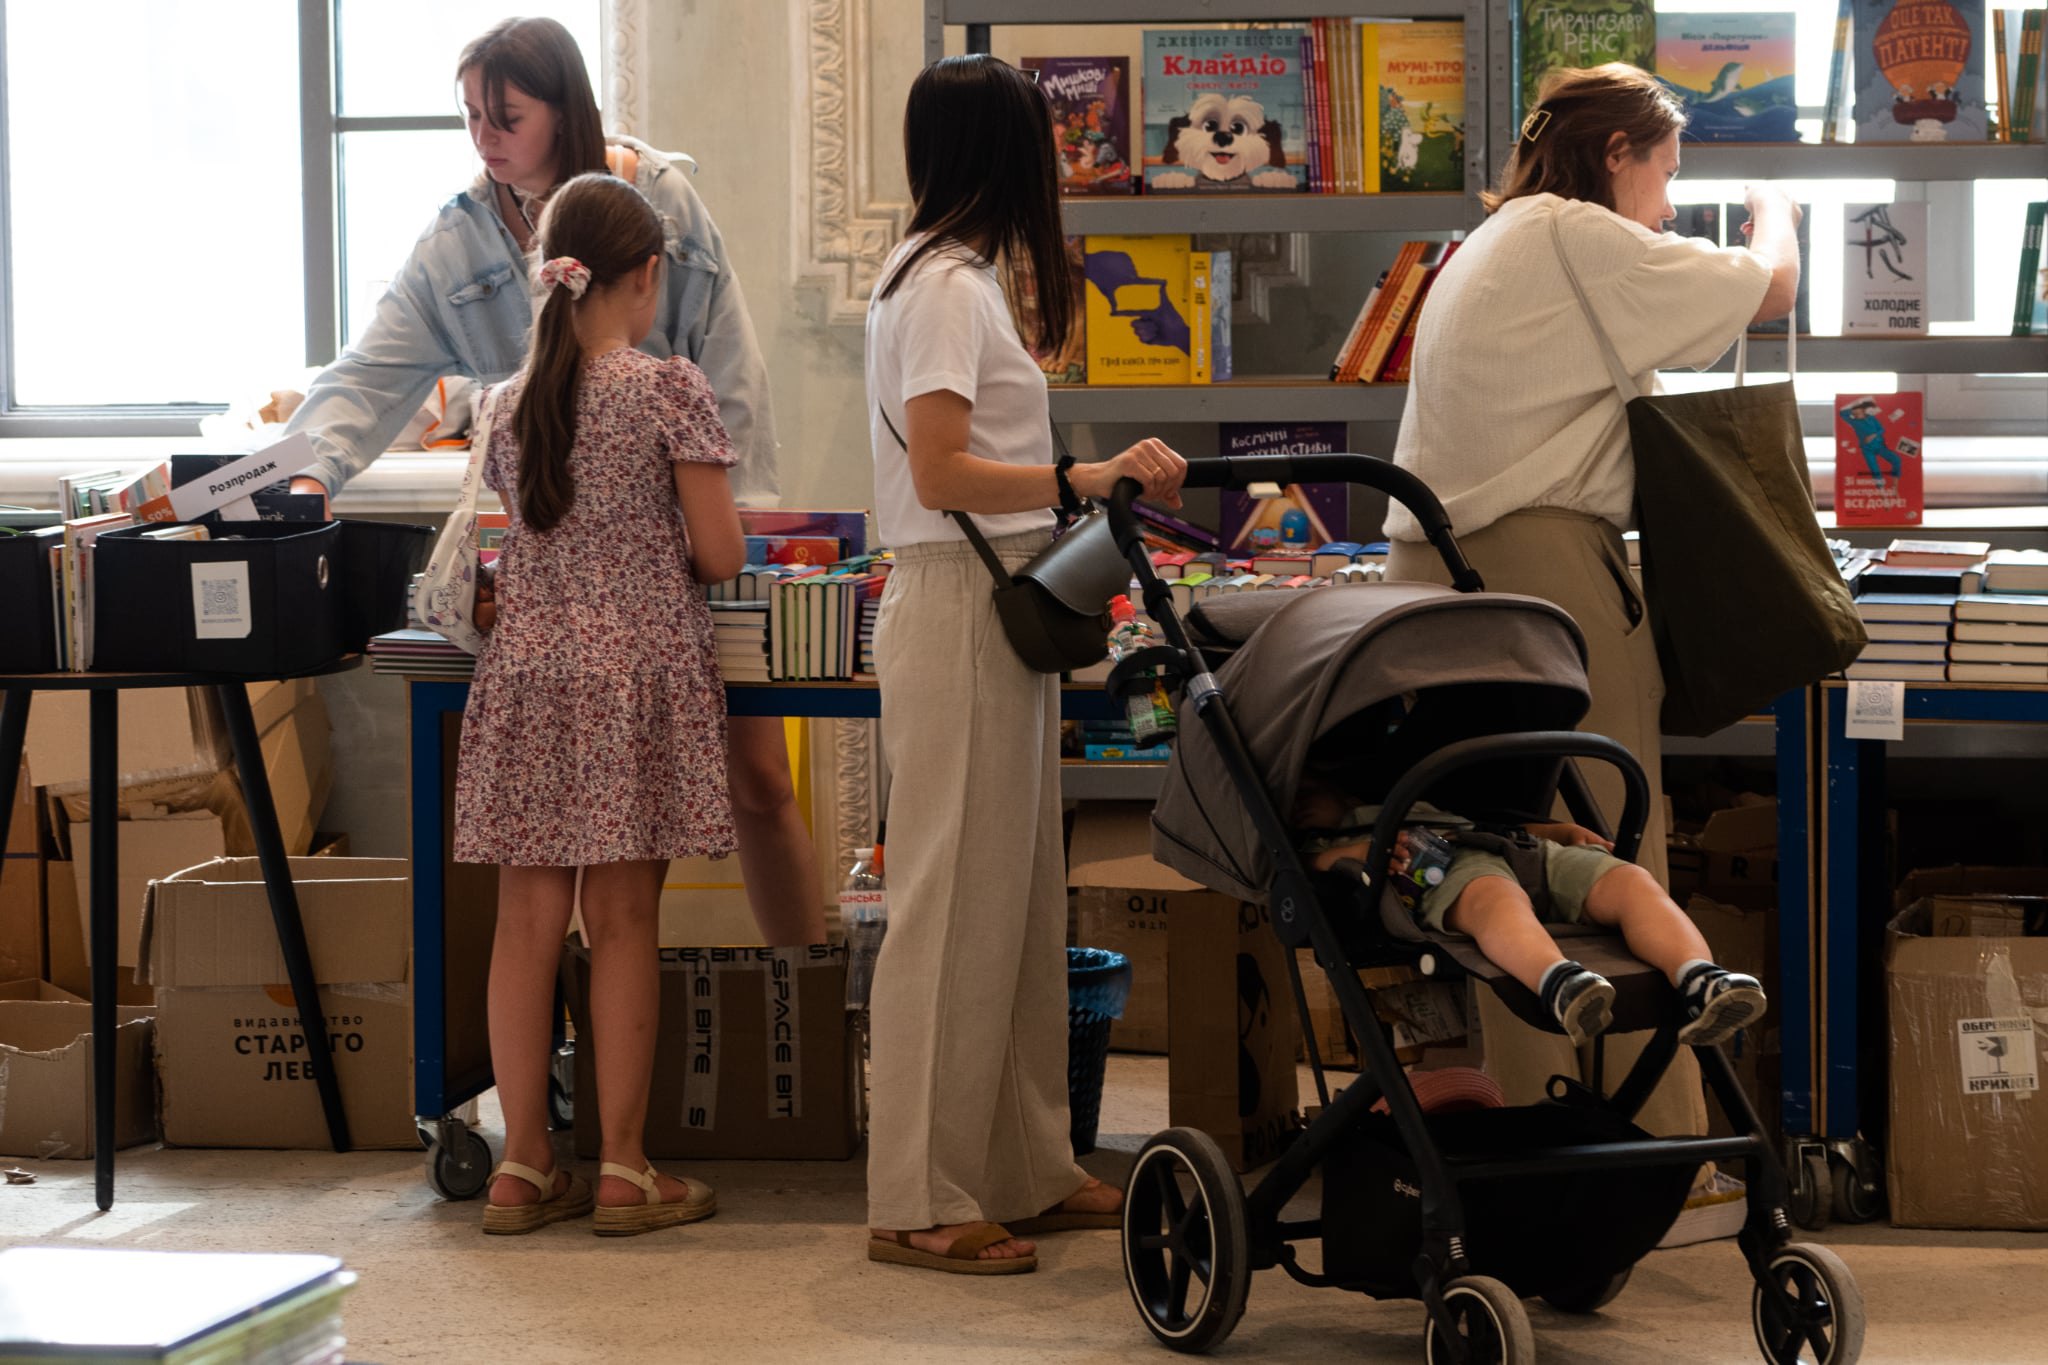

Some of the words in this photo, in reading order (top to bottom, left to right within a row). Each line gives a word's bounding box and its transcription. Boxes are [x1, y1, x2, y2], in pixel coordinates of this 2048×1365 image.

[1891, 6, 1920, 28] ОЦЕ
[1922, 5, 1955, 25] ТАК
[1564, 32, 1619, 54] РЕКС
[1878, 34, 1970, 70] ПАТЕНТ!
[1163, 53, 1286, 78] Клайдіо
[1387, 61, 1463, 74] МУМІ-ТРО
[1864, 299, 1921, 312] ХОЛОДНЕ
[1888, 316, 1921, 328] ПОЛЕ
[208, 460, 278, 496] Розпродаж
[234, 1016, 363, 1028] видавнтво
[772, 959, 792, 1063] SPACE
[235, 1033, 364, 1055] СТАРГО
[694, 1009, 712, 1074] BITE
[264, 1061, 316, 1081] ЛЕВ
